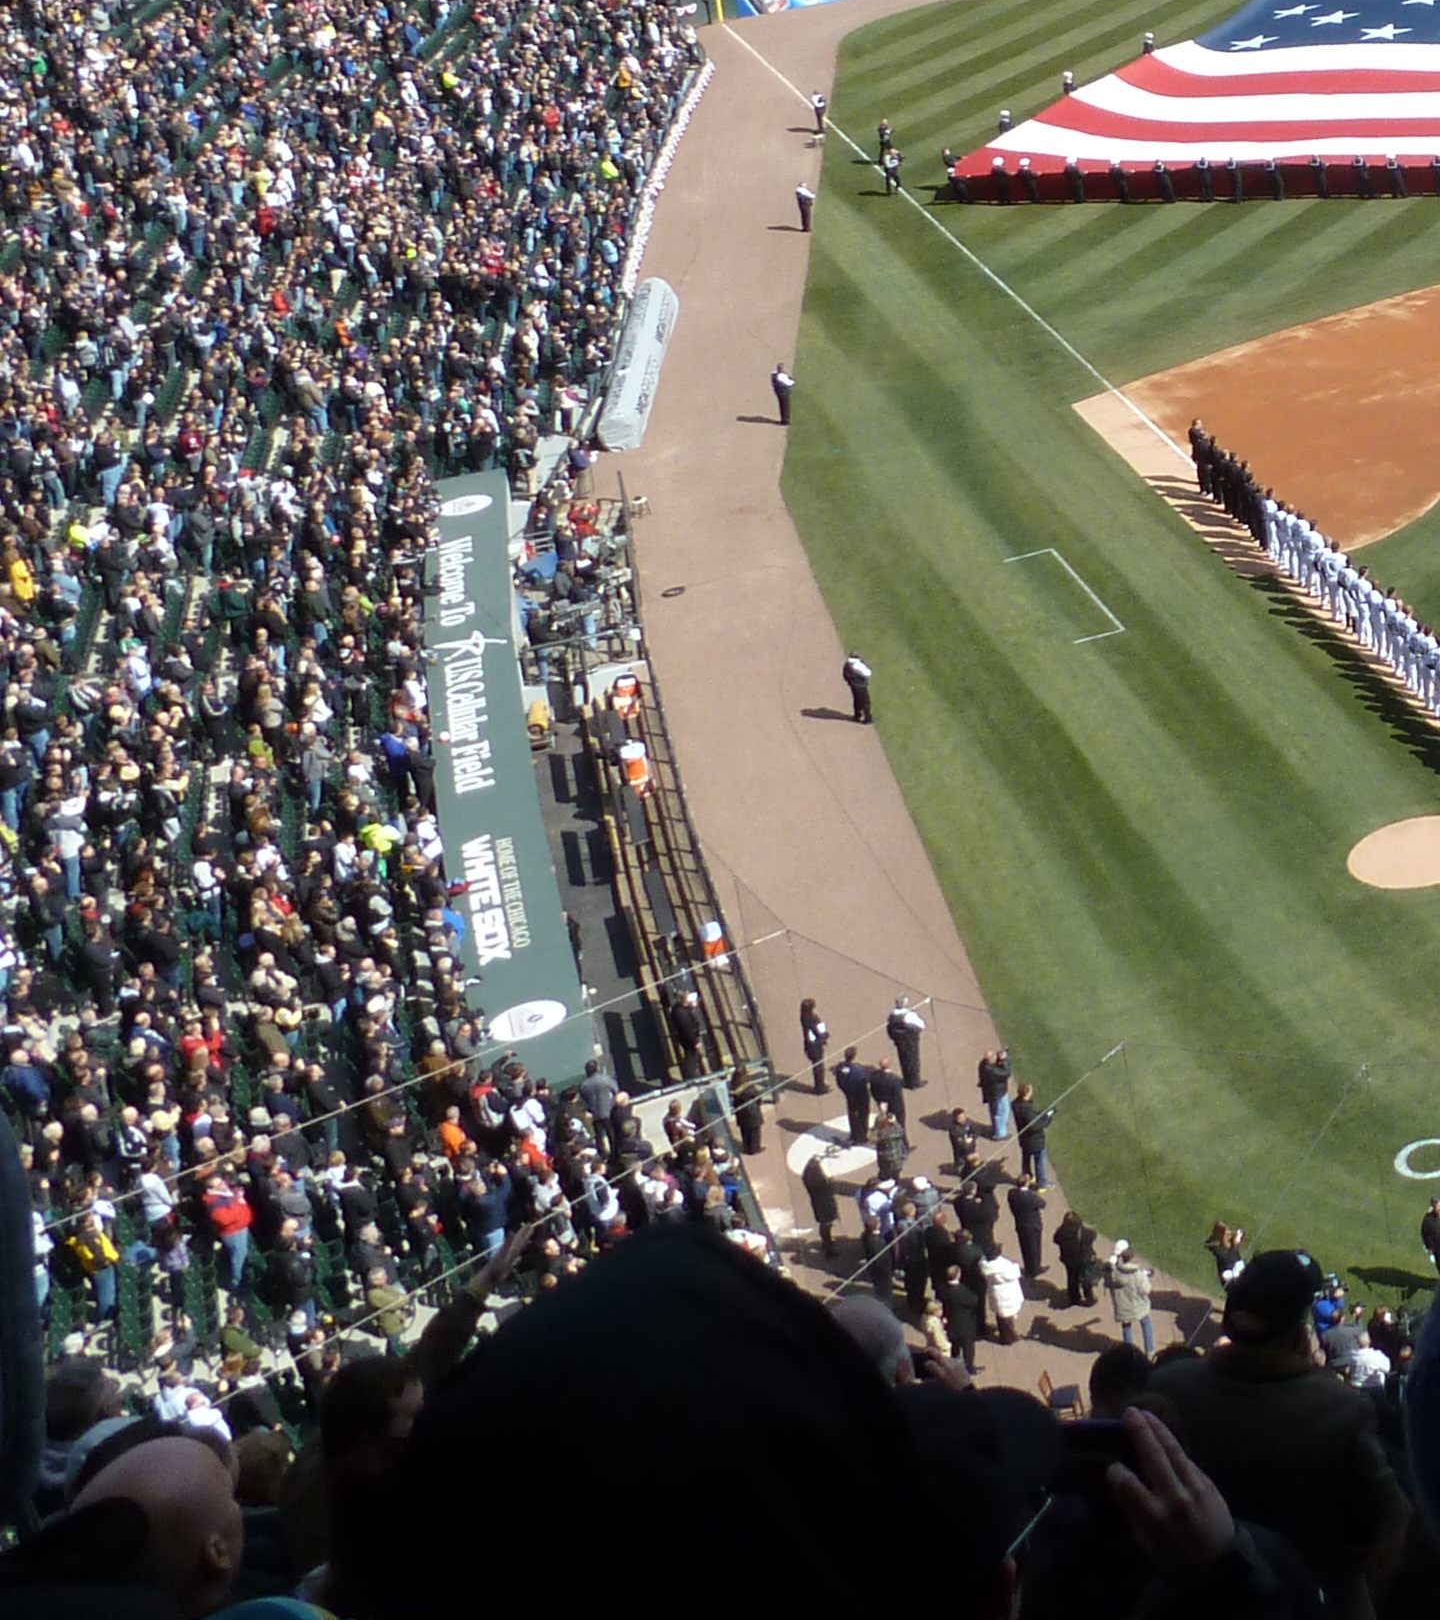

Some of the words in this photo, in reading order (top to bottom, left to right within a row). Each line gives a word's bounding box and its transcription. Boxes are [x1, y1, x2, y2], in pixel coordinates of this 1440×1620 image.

[439, 535, 475, 603] Welcome
[440, 601, 476, 627] To
[445, 679, 489, 742] Cellular
[452, 739, 496, 795] Field
[461, 833, 502, 912] WHITE
[495, 836, 516, 868] HOME
[500, 866, 519, 880] OF
[503, 879, 523, 902] THE
[471, 911, 512, 967] SOX
[506, 899, 532, 949] CHICAGO
